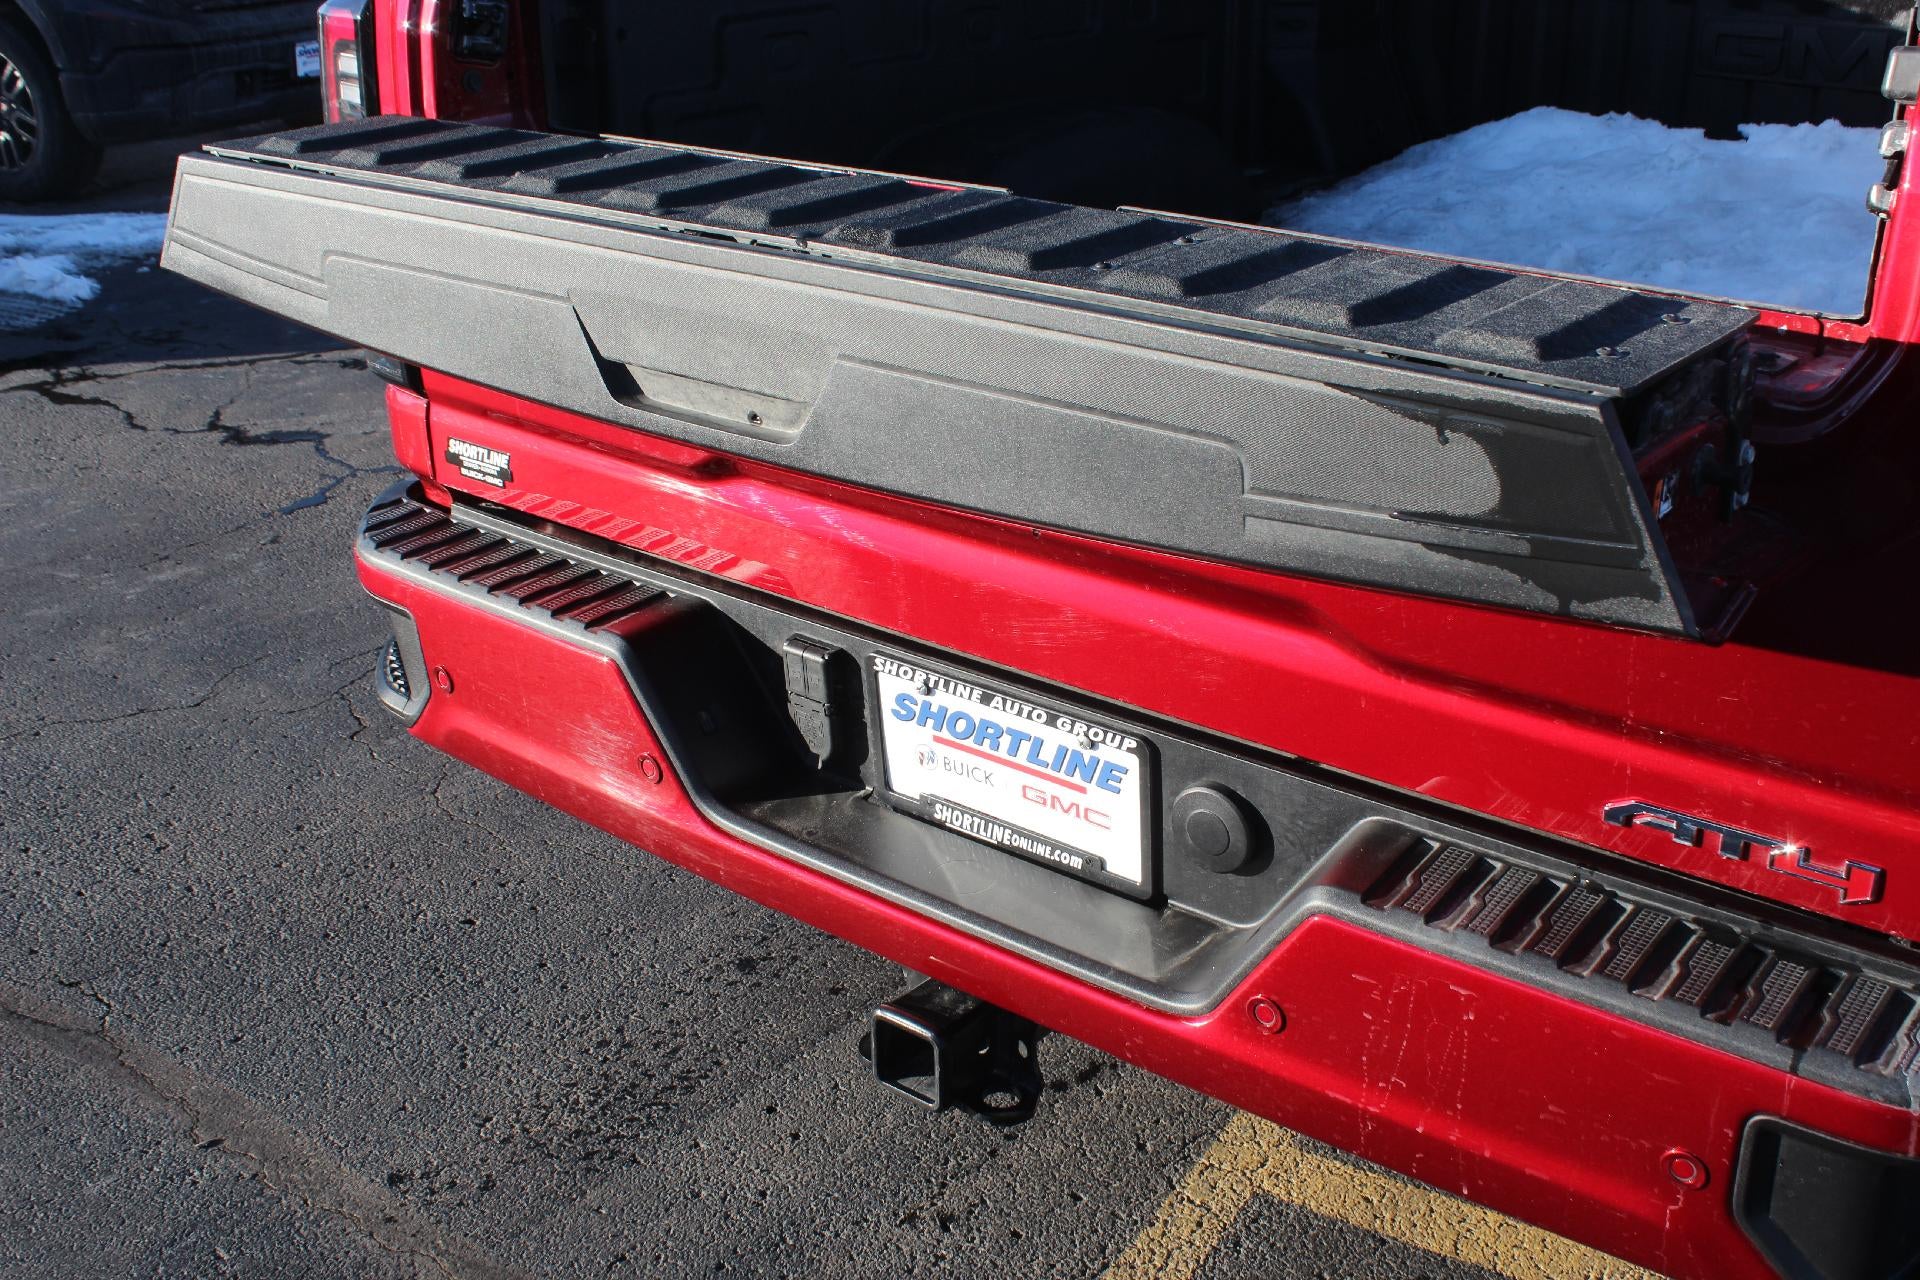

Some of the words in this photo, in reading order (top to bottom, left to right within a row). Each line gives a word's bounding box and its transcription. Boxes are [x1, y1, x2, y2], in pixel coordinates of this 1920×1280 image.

[1698, 18, 1892, 86] GM
[447, 438, 510, 469] SHORTLINE
[873, 657, 984, 704] SHORTLINE
[988, 695, 1048, 724] AUTO
[1056, 716, 1138, 752] GROUP
[890, 692, 1130, 795] SHORTLINE
[942, 756, 995, 787] BUICK
[1021, 784, 1113, 831] GMC
[1603, 797, 1884, 905] AT4
